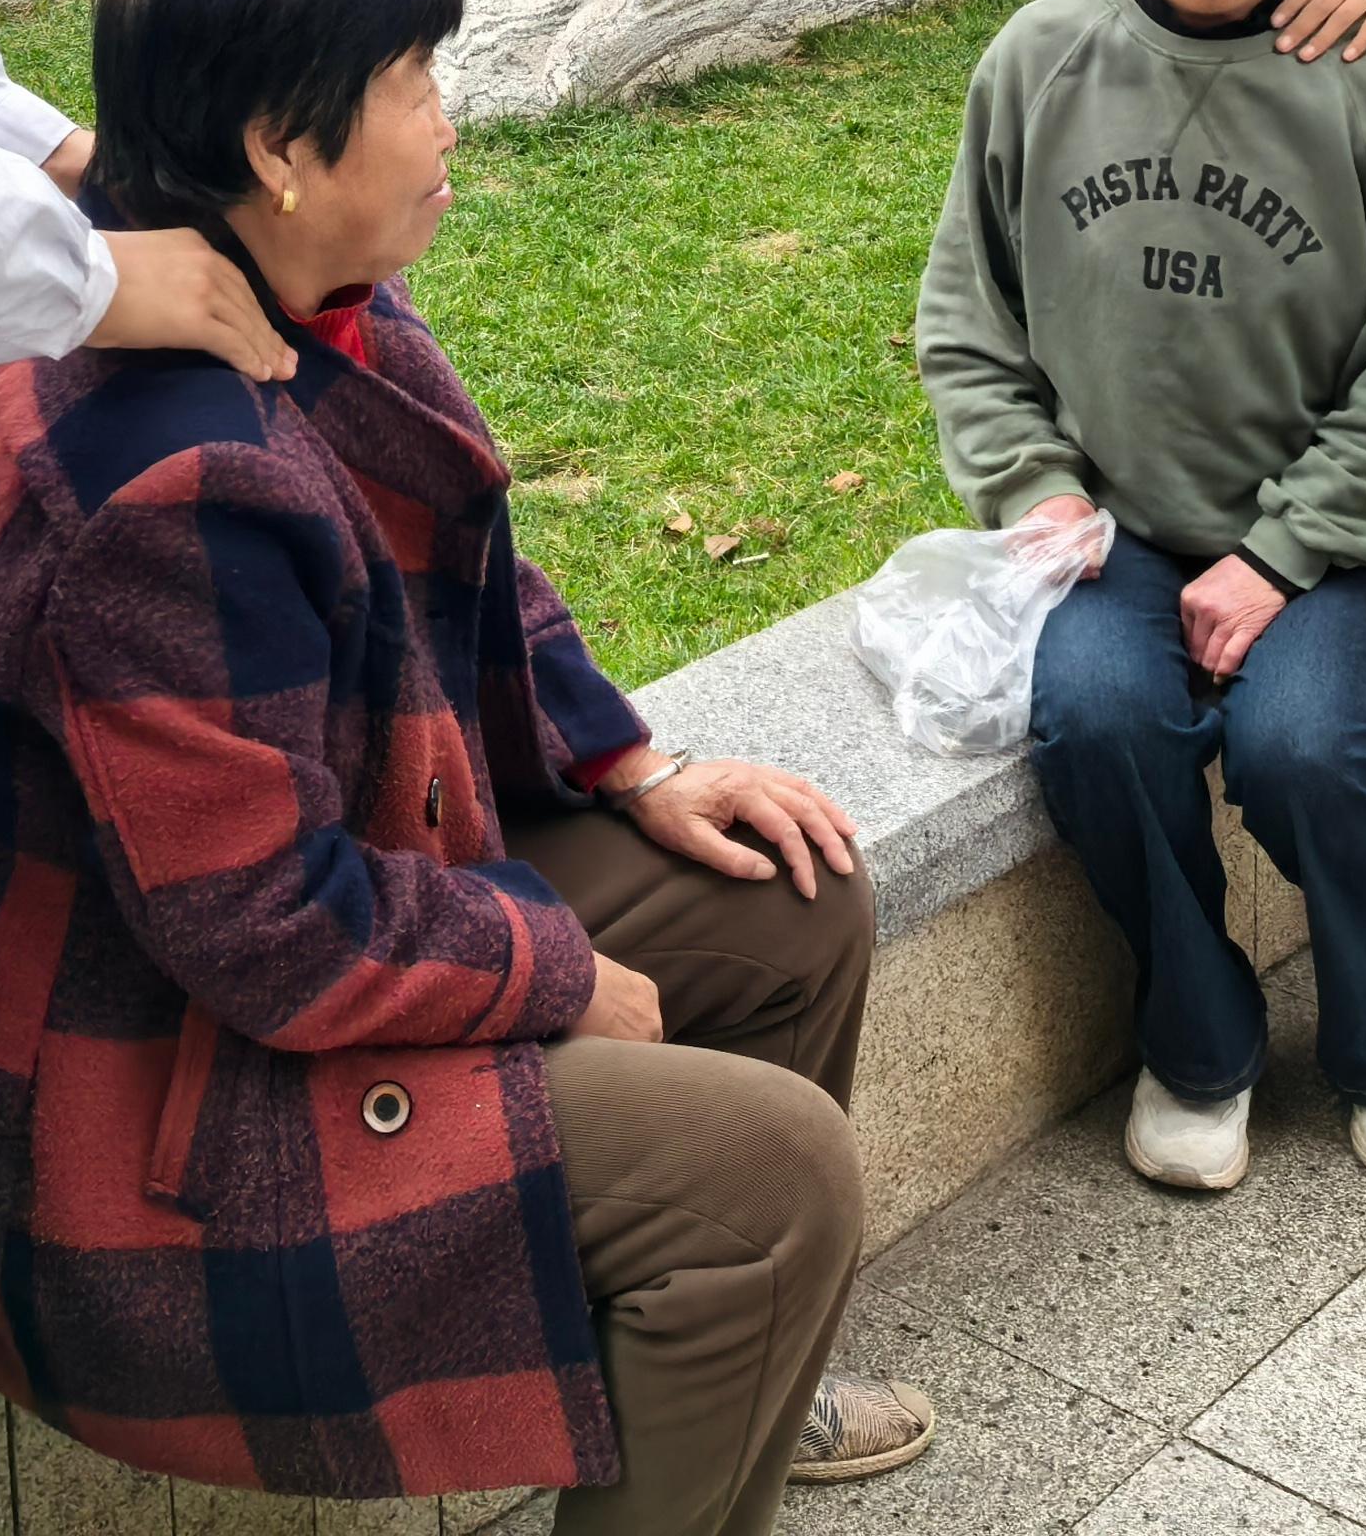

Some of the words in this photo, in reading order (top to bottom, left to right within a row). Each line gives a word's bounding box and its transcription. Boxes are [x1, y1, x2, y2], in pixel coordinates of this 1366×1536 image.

[1060, 157, 1180, 232] PASTA
[1193, 163, 1324, 265] PARTY
[1143, 246, 1223, 298] USA
